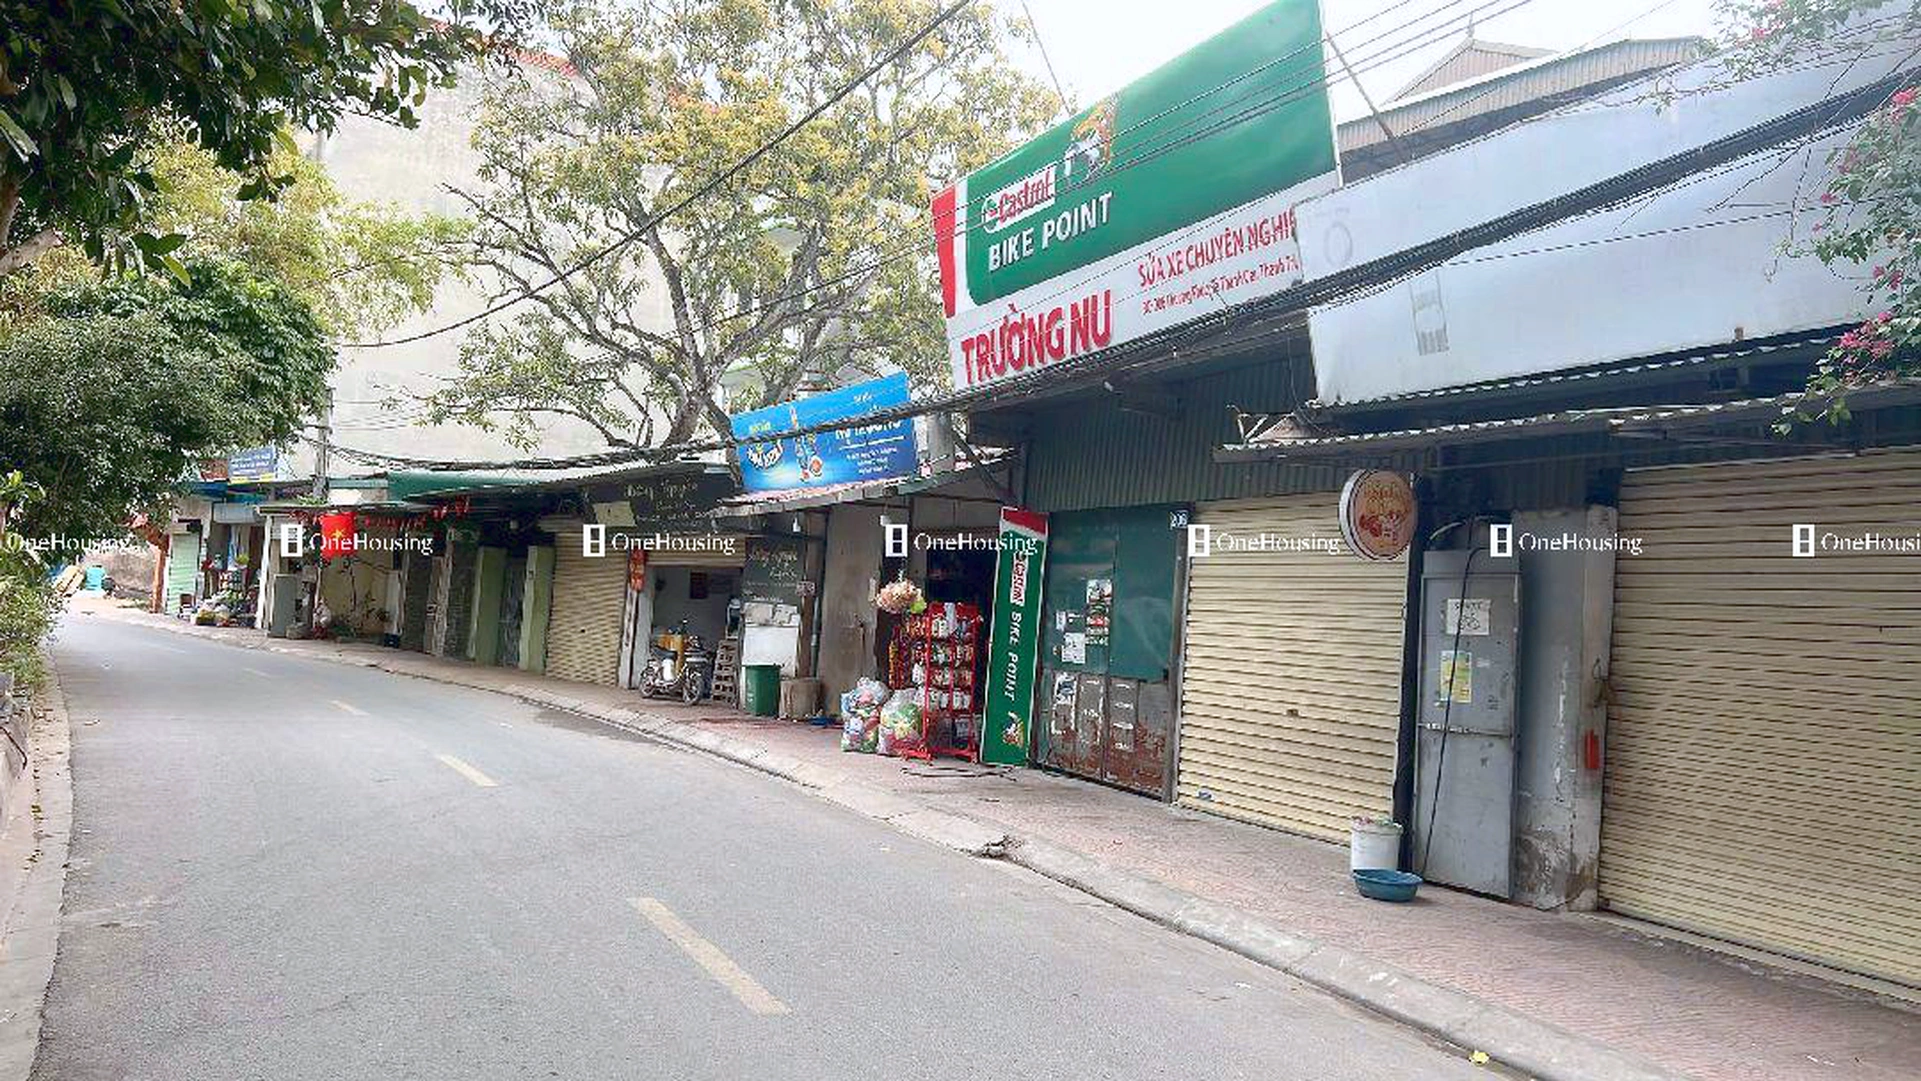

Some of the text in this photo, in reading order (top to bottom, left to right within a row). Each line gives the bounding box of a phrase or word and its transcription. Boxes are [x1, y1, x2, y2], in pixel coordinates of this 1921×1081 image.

[989, 191, 1114, 273] BIKE POINT
[999, 168, 1053, 224] Castrol
[1168, 251, 1184, 279] XE
[1185, 227, 1244, 272] CHUYÊN
[961, 289, 1112, 386] TRƯỜNG NU
[1003, 612, 1023, 702] BIKE POINT
